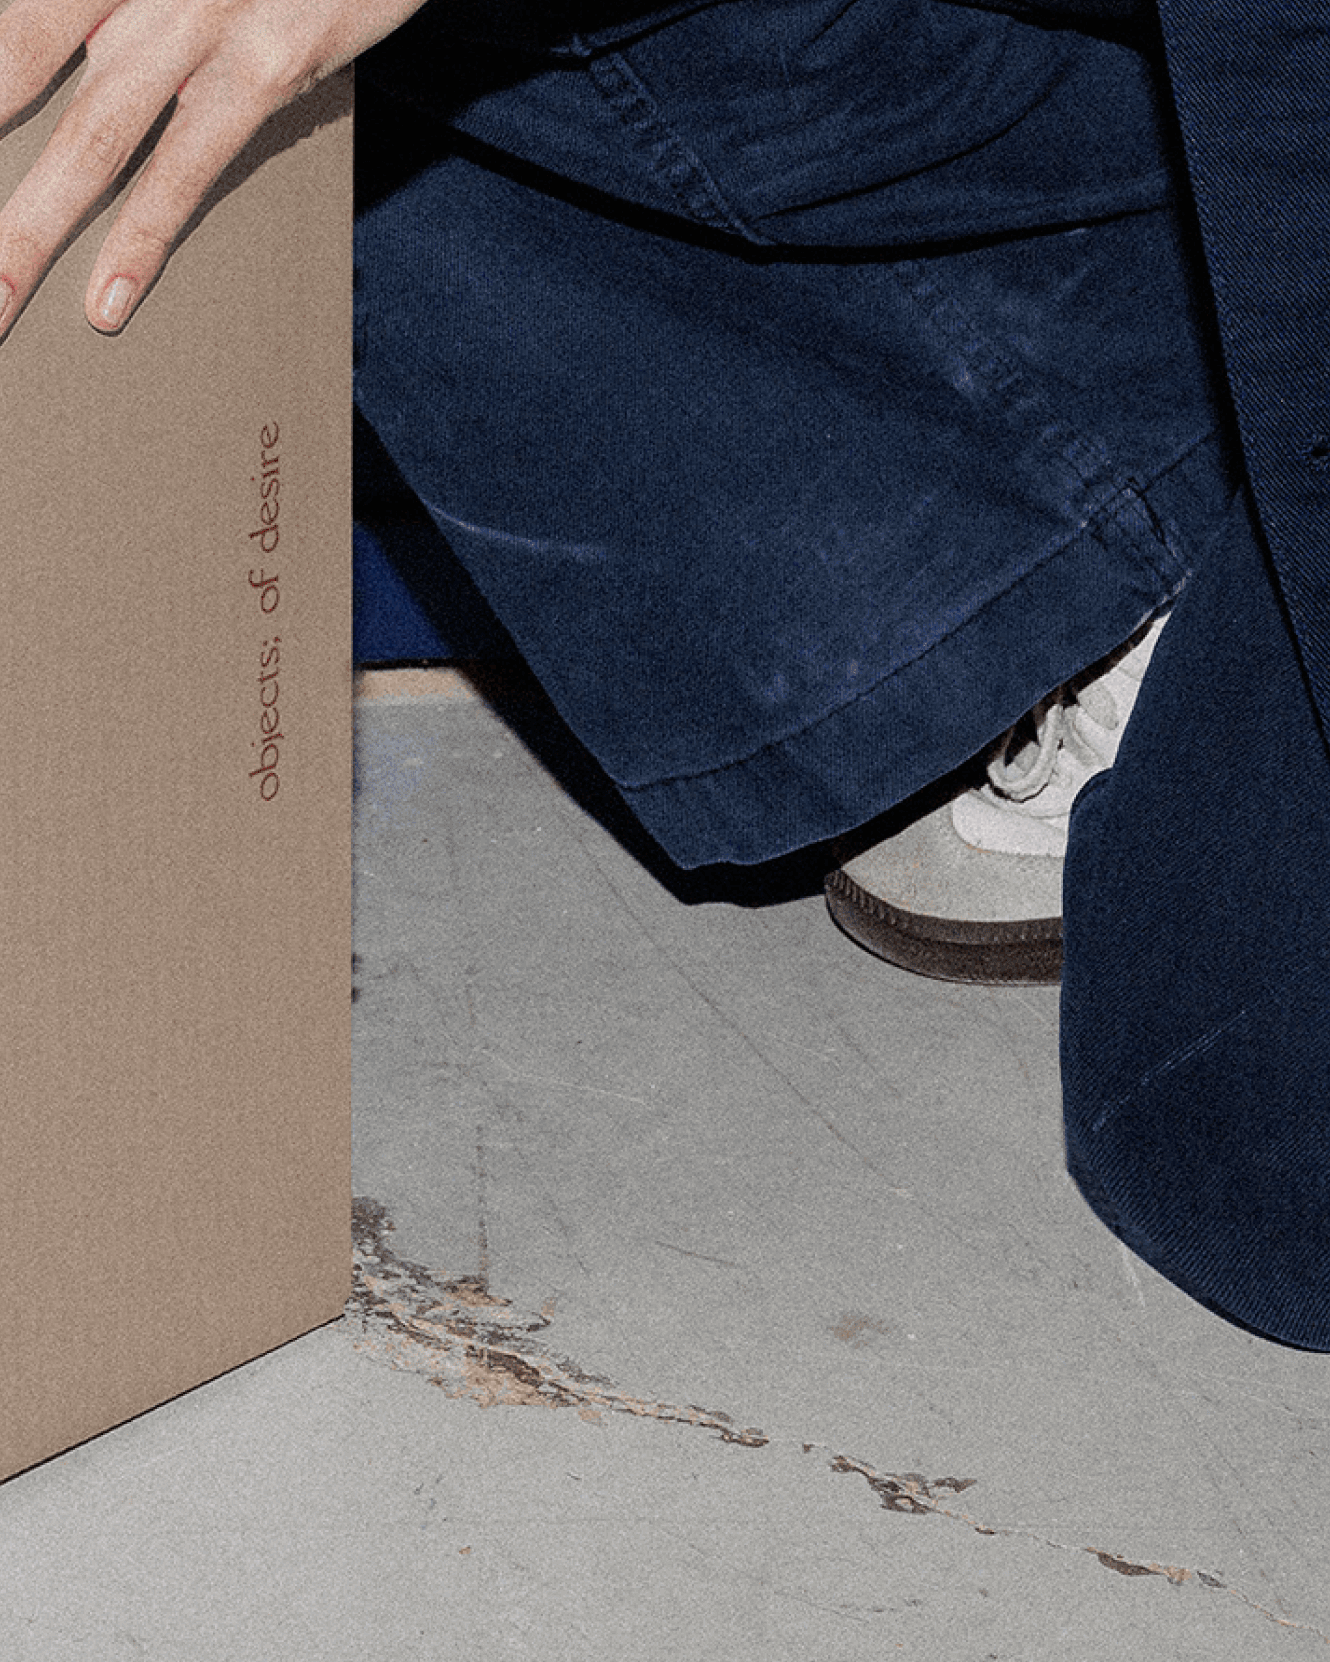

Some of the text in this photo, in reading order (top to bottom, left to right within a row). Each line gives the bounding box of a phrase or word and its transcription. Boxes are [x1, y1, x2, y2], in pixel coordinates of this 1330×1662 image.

[247, 420, 285, 802] objects; of desire
